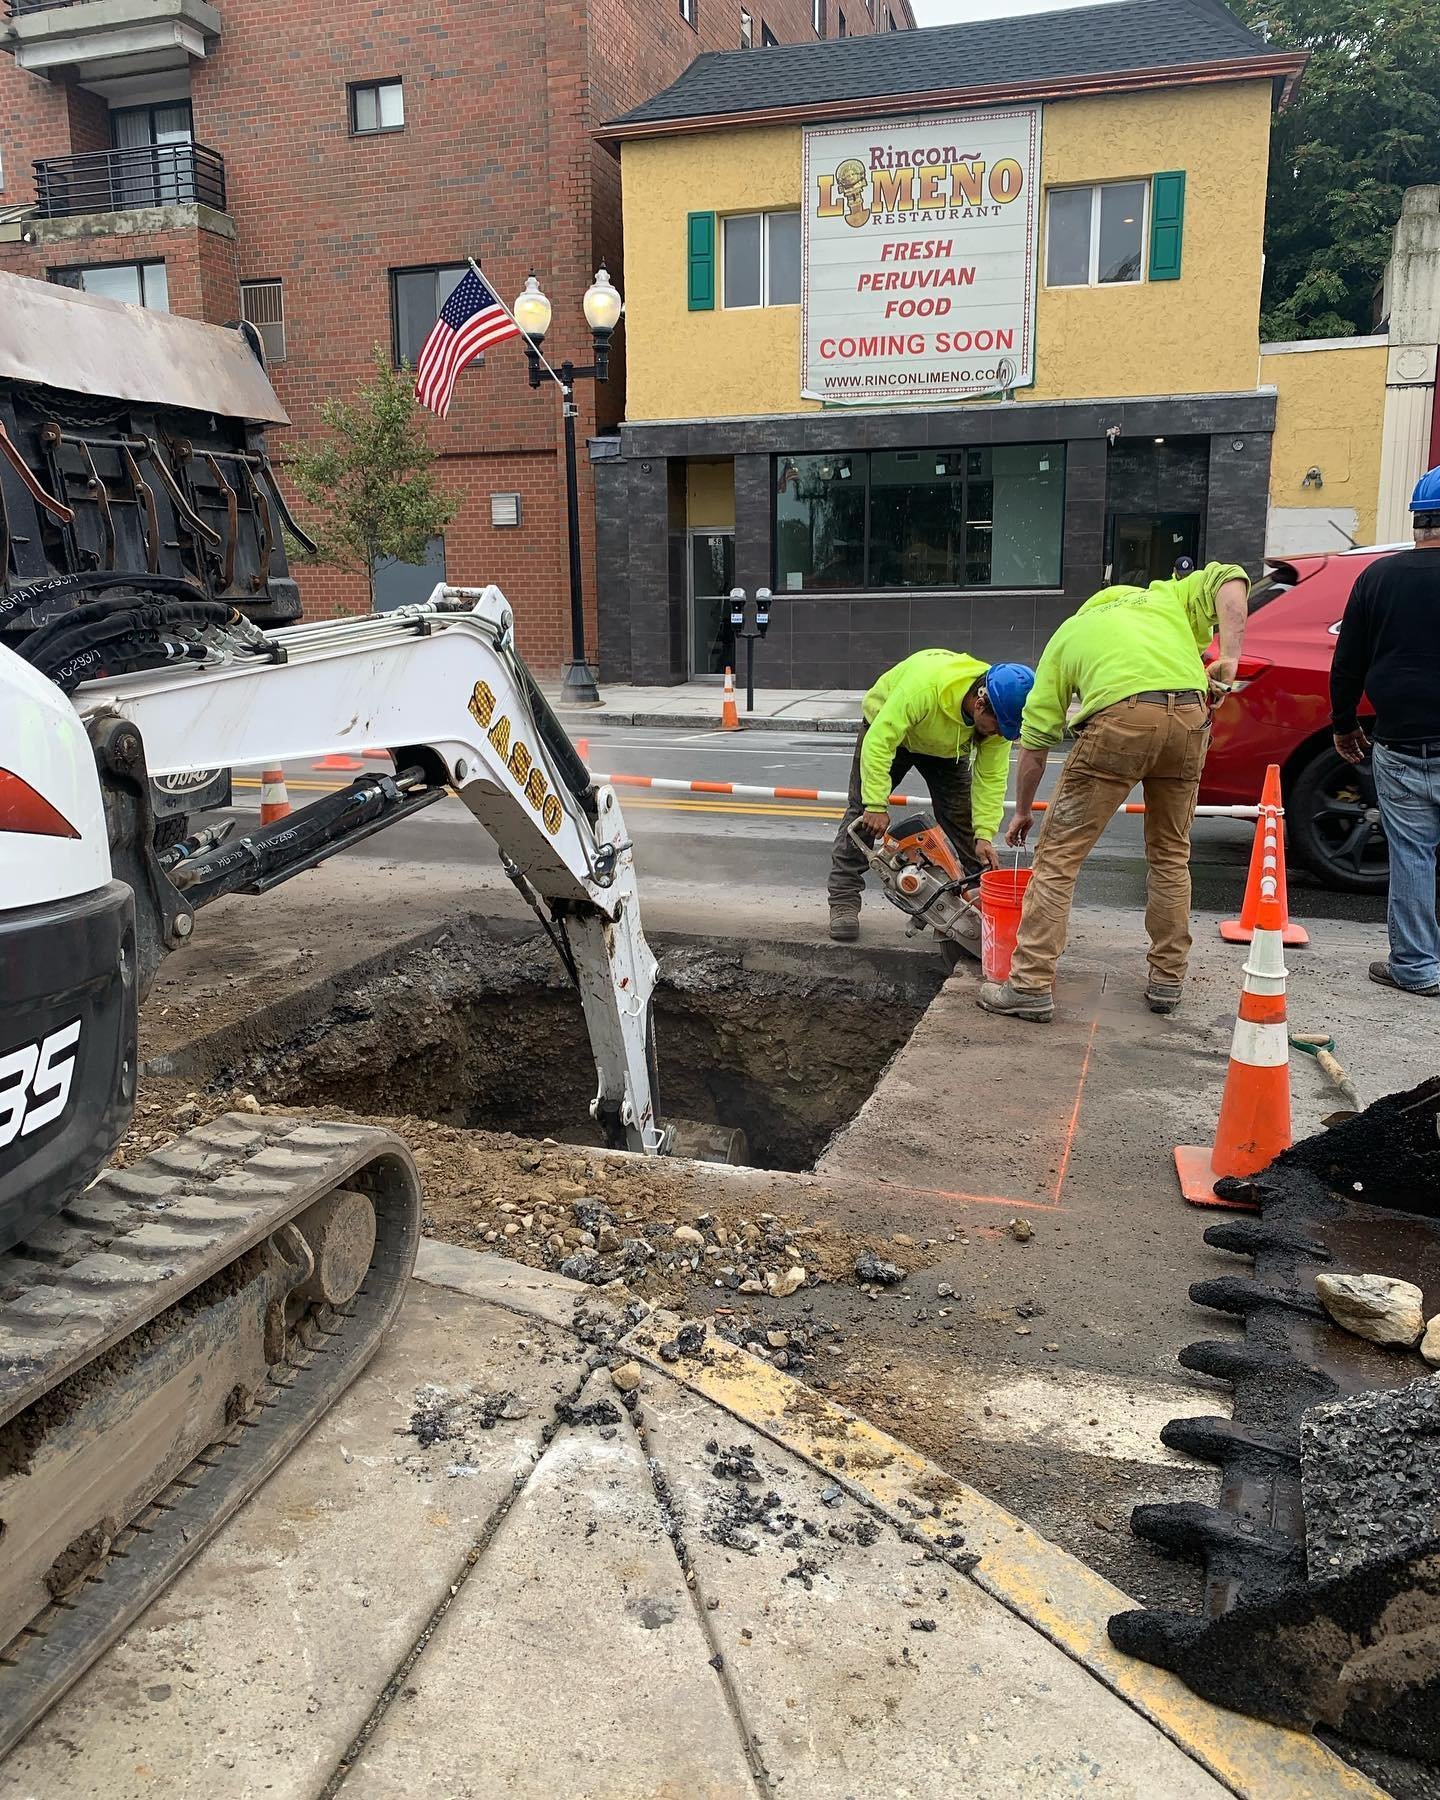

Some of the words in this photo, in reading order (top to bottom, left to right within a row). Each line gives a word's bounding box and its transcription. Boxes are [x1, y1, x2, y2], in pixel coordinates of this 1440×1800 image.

[869, 145, 958, 171] Rincon
[872, 205, 1002, 226] RESTAURANT
[880, 239, 953, 262] FRESH
[857, 267, 976, 292] PERUVIAN
[884, 297, 952, 319] FOOD
[819, 334, 925, 360] COMING
[935, 329, 1014, 352] SOON
[824, 368, 1007, 388] WWW.RINCONLIMENO.COM
